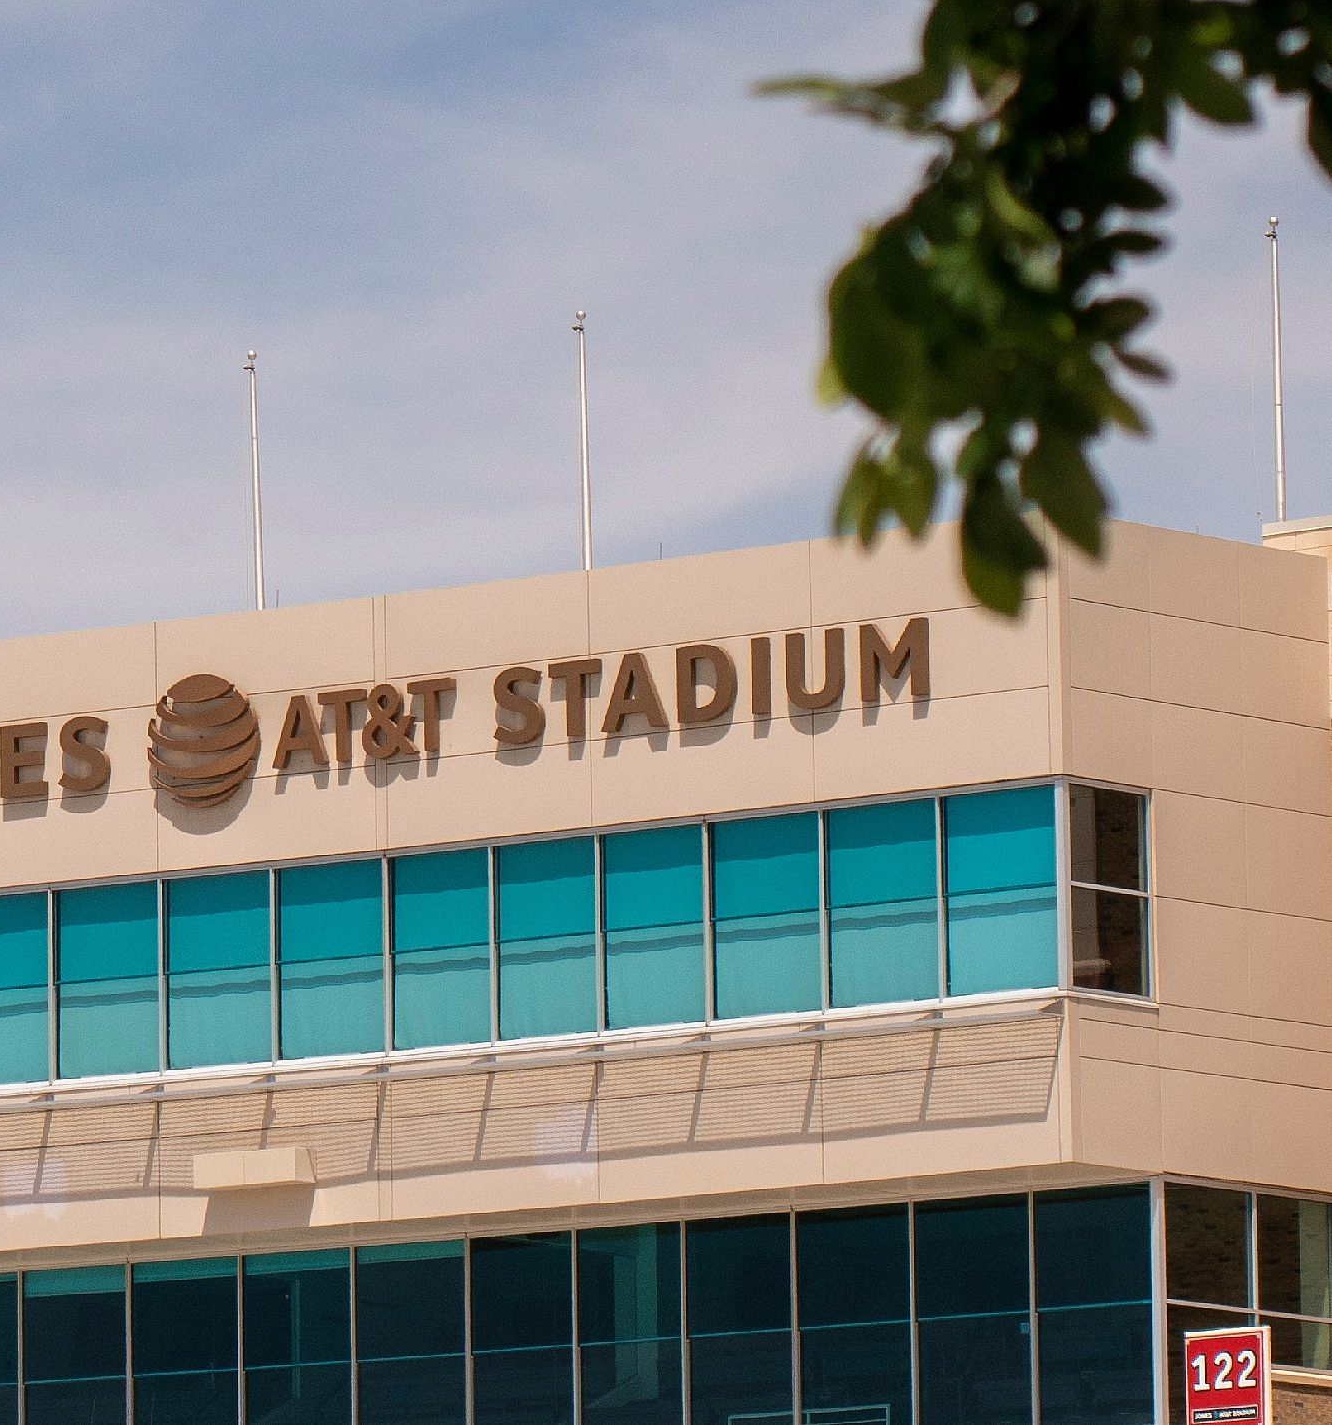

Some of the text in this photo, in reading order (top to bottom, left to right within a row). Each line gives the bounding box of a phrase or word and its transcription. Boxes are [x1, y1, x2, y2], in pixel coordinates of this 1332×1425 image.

[272, 677, 456, 770] AT&T
[492, 617, 929, 745] STADIUM
[1191, 1350, 1257, 1391] 122
